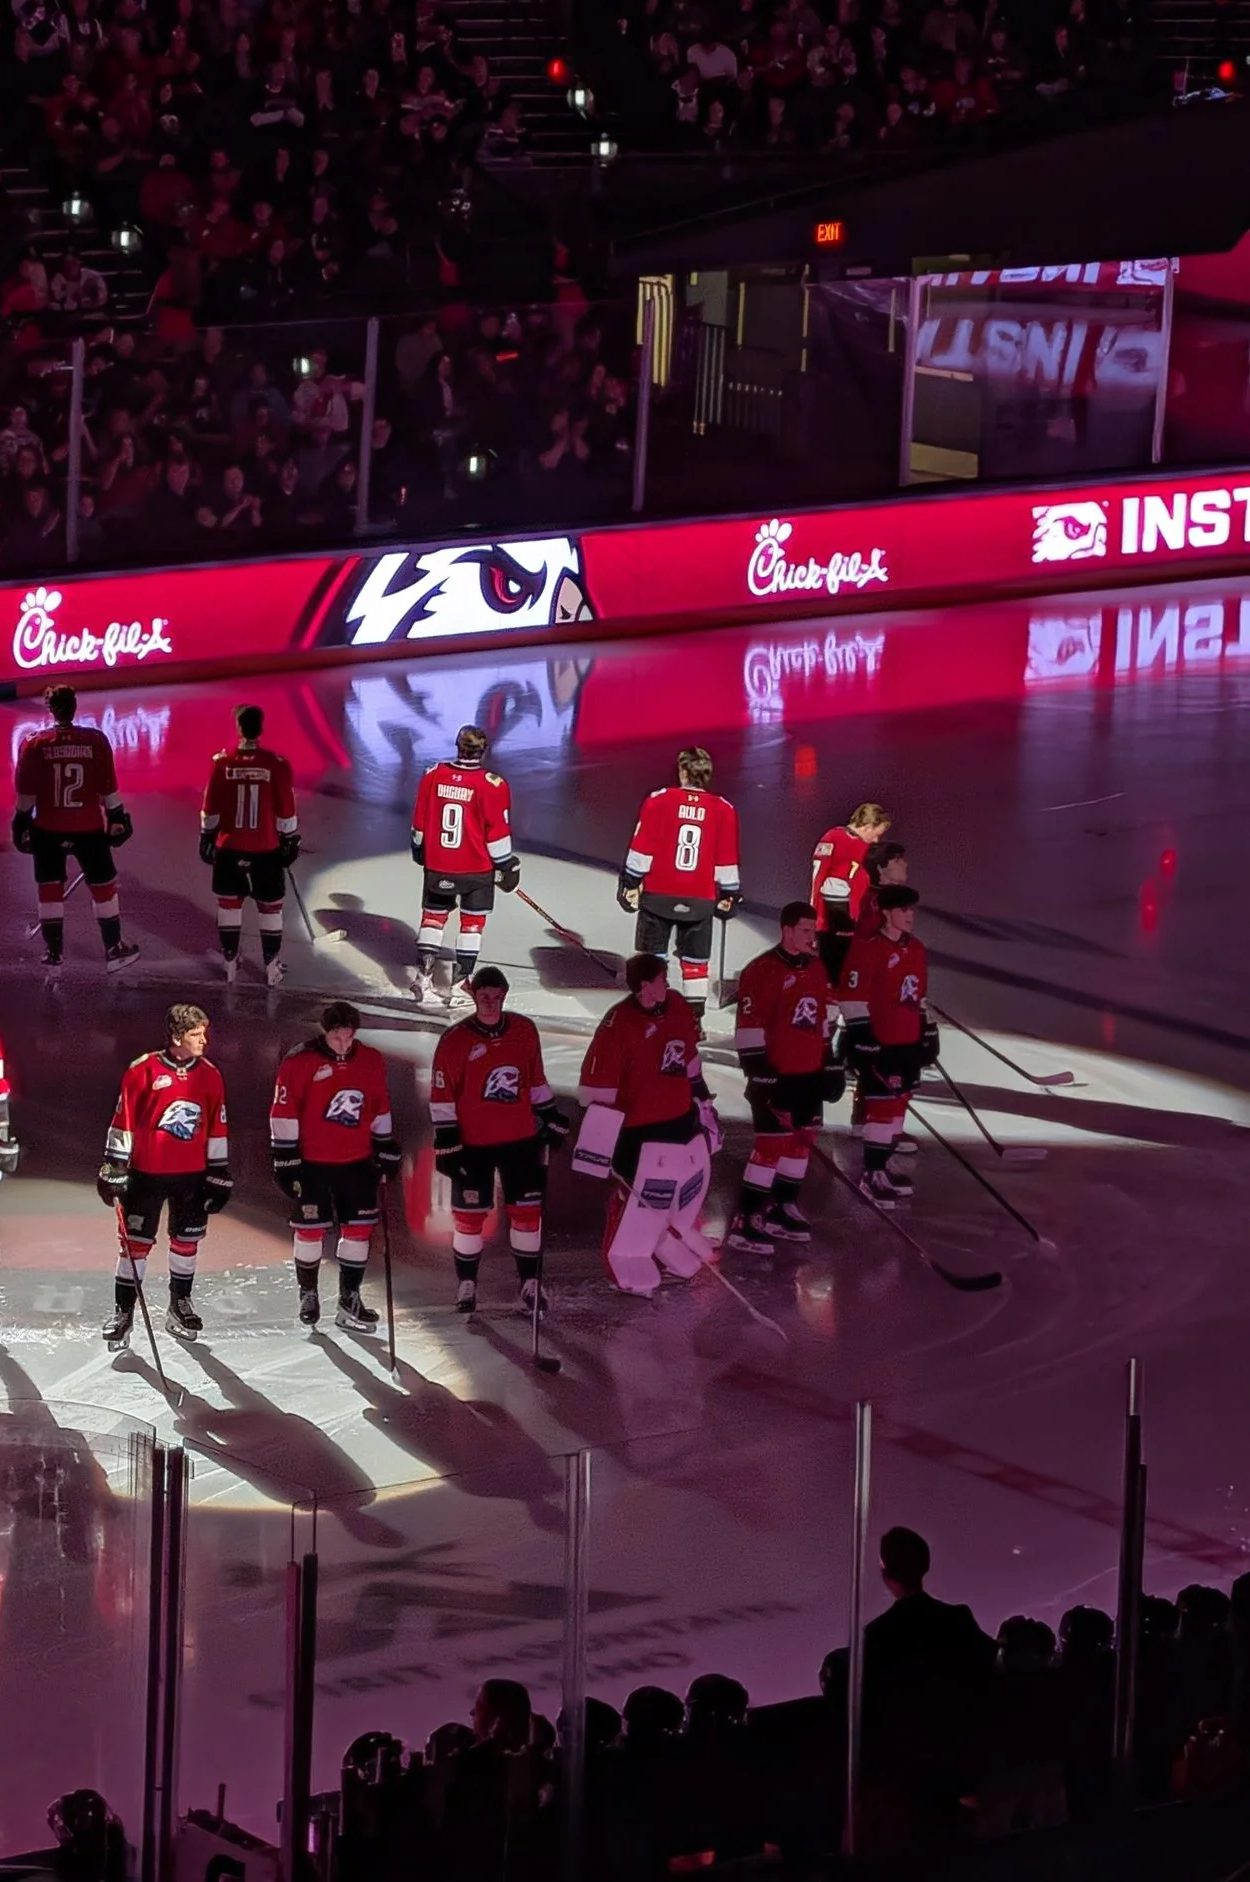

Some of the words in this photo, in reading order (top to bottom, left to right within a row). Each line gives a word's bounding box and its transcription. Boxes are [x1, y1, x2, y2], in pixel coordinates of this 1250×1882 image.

[817, 222, 840, 242] EXIT
[748, 538, 888, 596] Chick-fil-A
[13, 607, 172, 669] Chick-fil-A
[53, 763, 84, 808] 12
[437, 783, 474, 802] DUGUAY
[235, 784, 259, 829] 11
[678, 804, 706, 822] AULD
[440, 803, 463, 849] 9
[675, 824, 701, 872] 8
[849, 860, 859, 880] 7
[848, 970, 859, 988] 3
[742, 997, 752, 1015] 2
